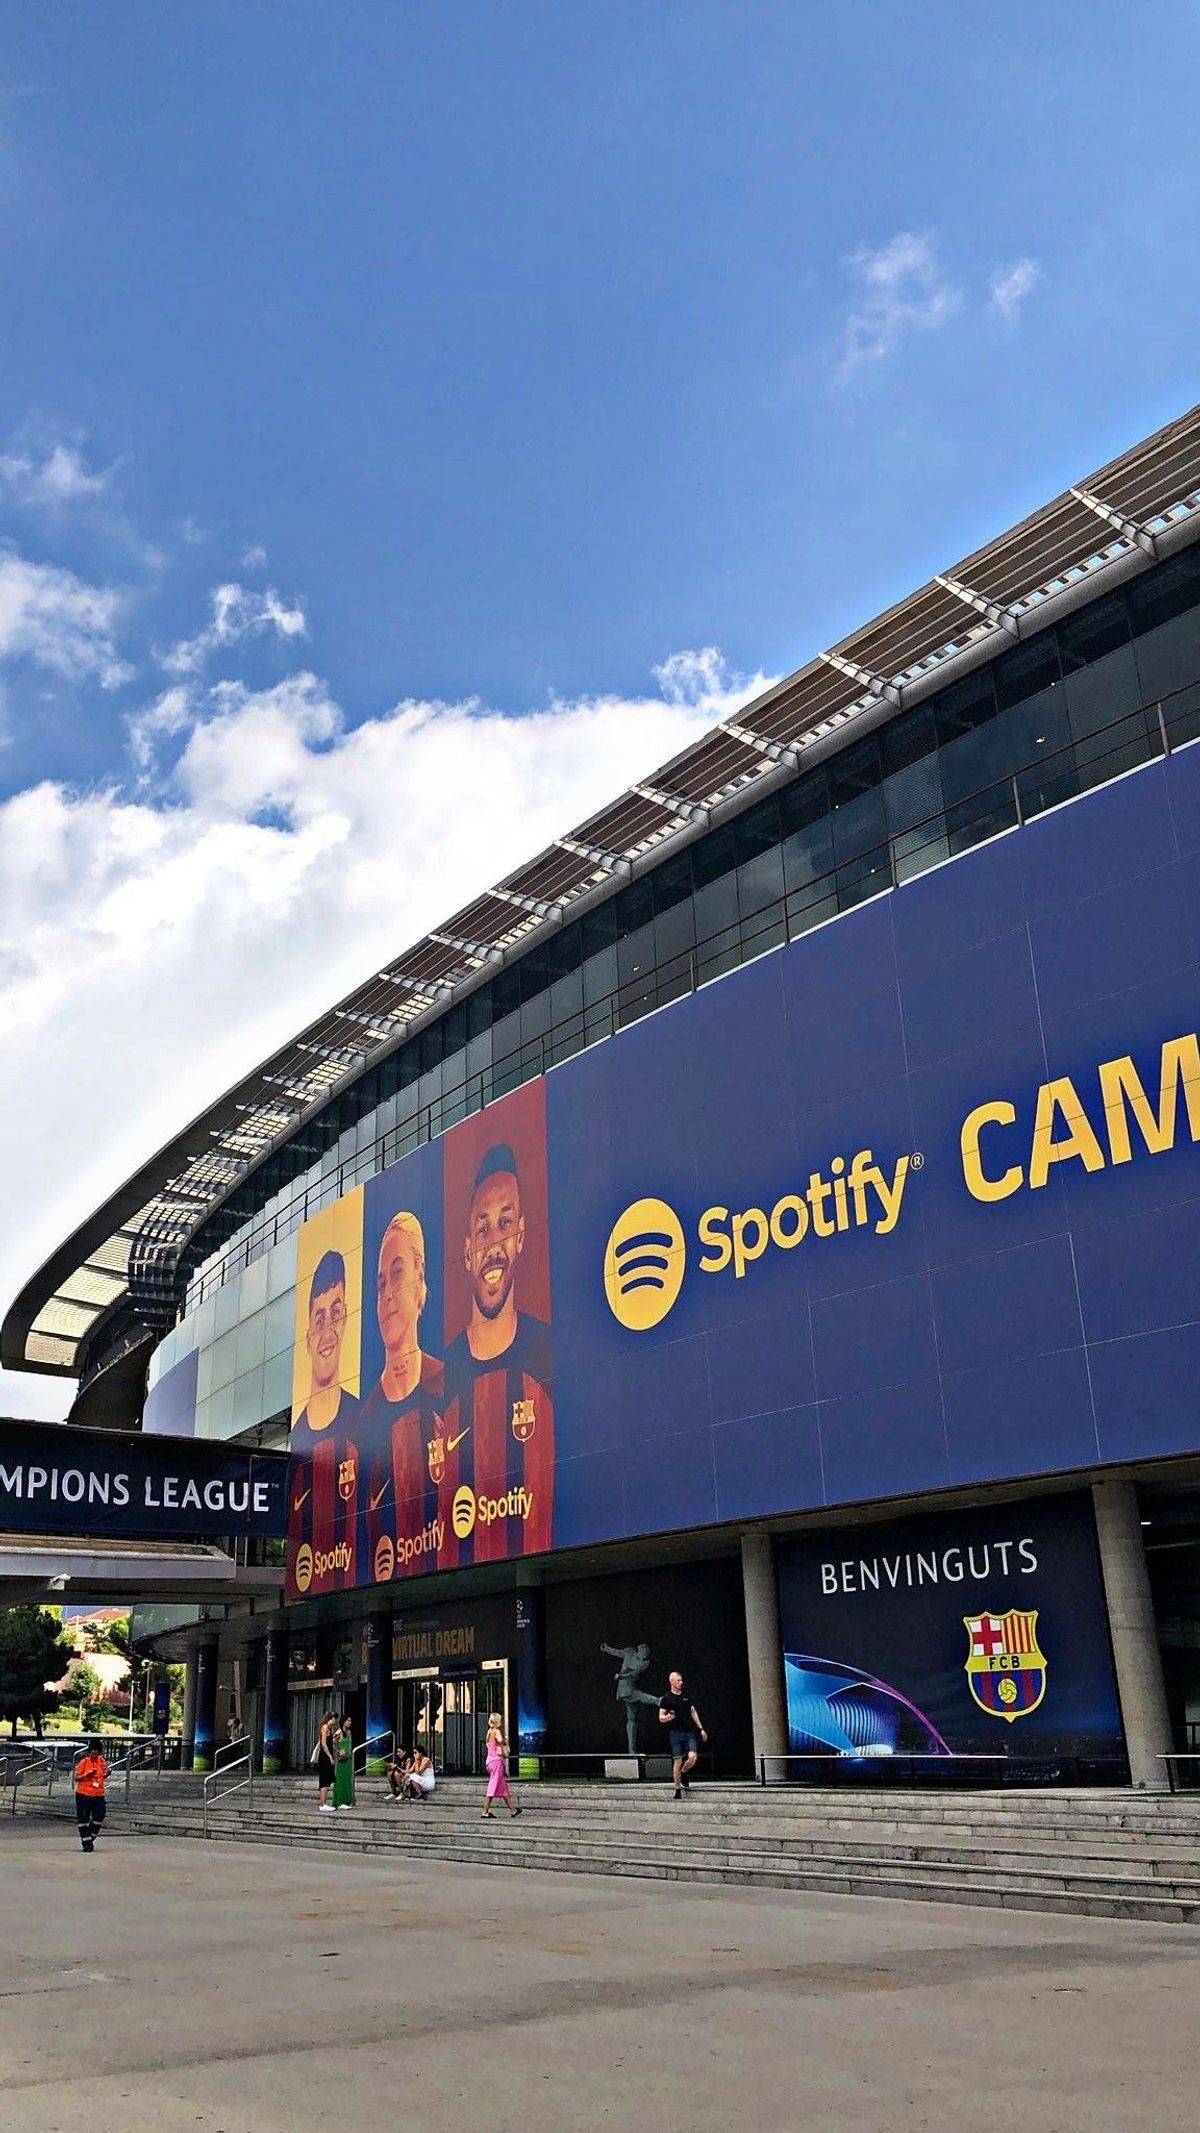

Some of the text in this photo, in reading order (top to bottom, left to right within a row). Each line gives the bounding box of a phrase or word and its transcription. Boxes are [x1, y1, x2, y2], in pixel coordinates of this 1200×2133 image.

[477, 1486, 534, 1526] Spotify
[314, 1542, 353, 1576] Spotify
[396, 1520, 446, 1563] Spotify
[820, 1538, 1038, 1595] BENVINGUTS
[436, 1626, 475, 1656] DREAM
[988, 1655, 1021, 1670] FCB
